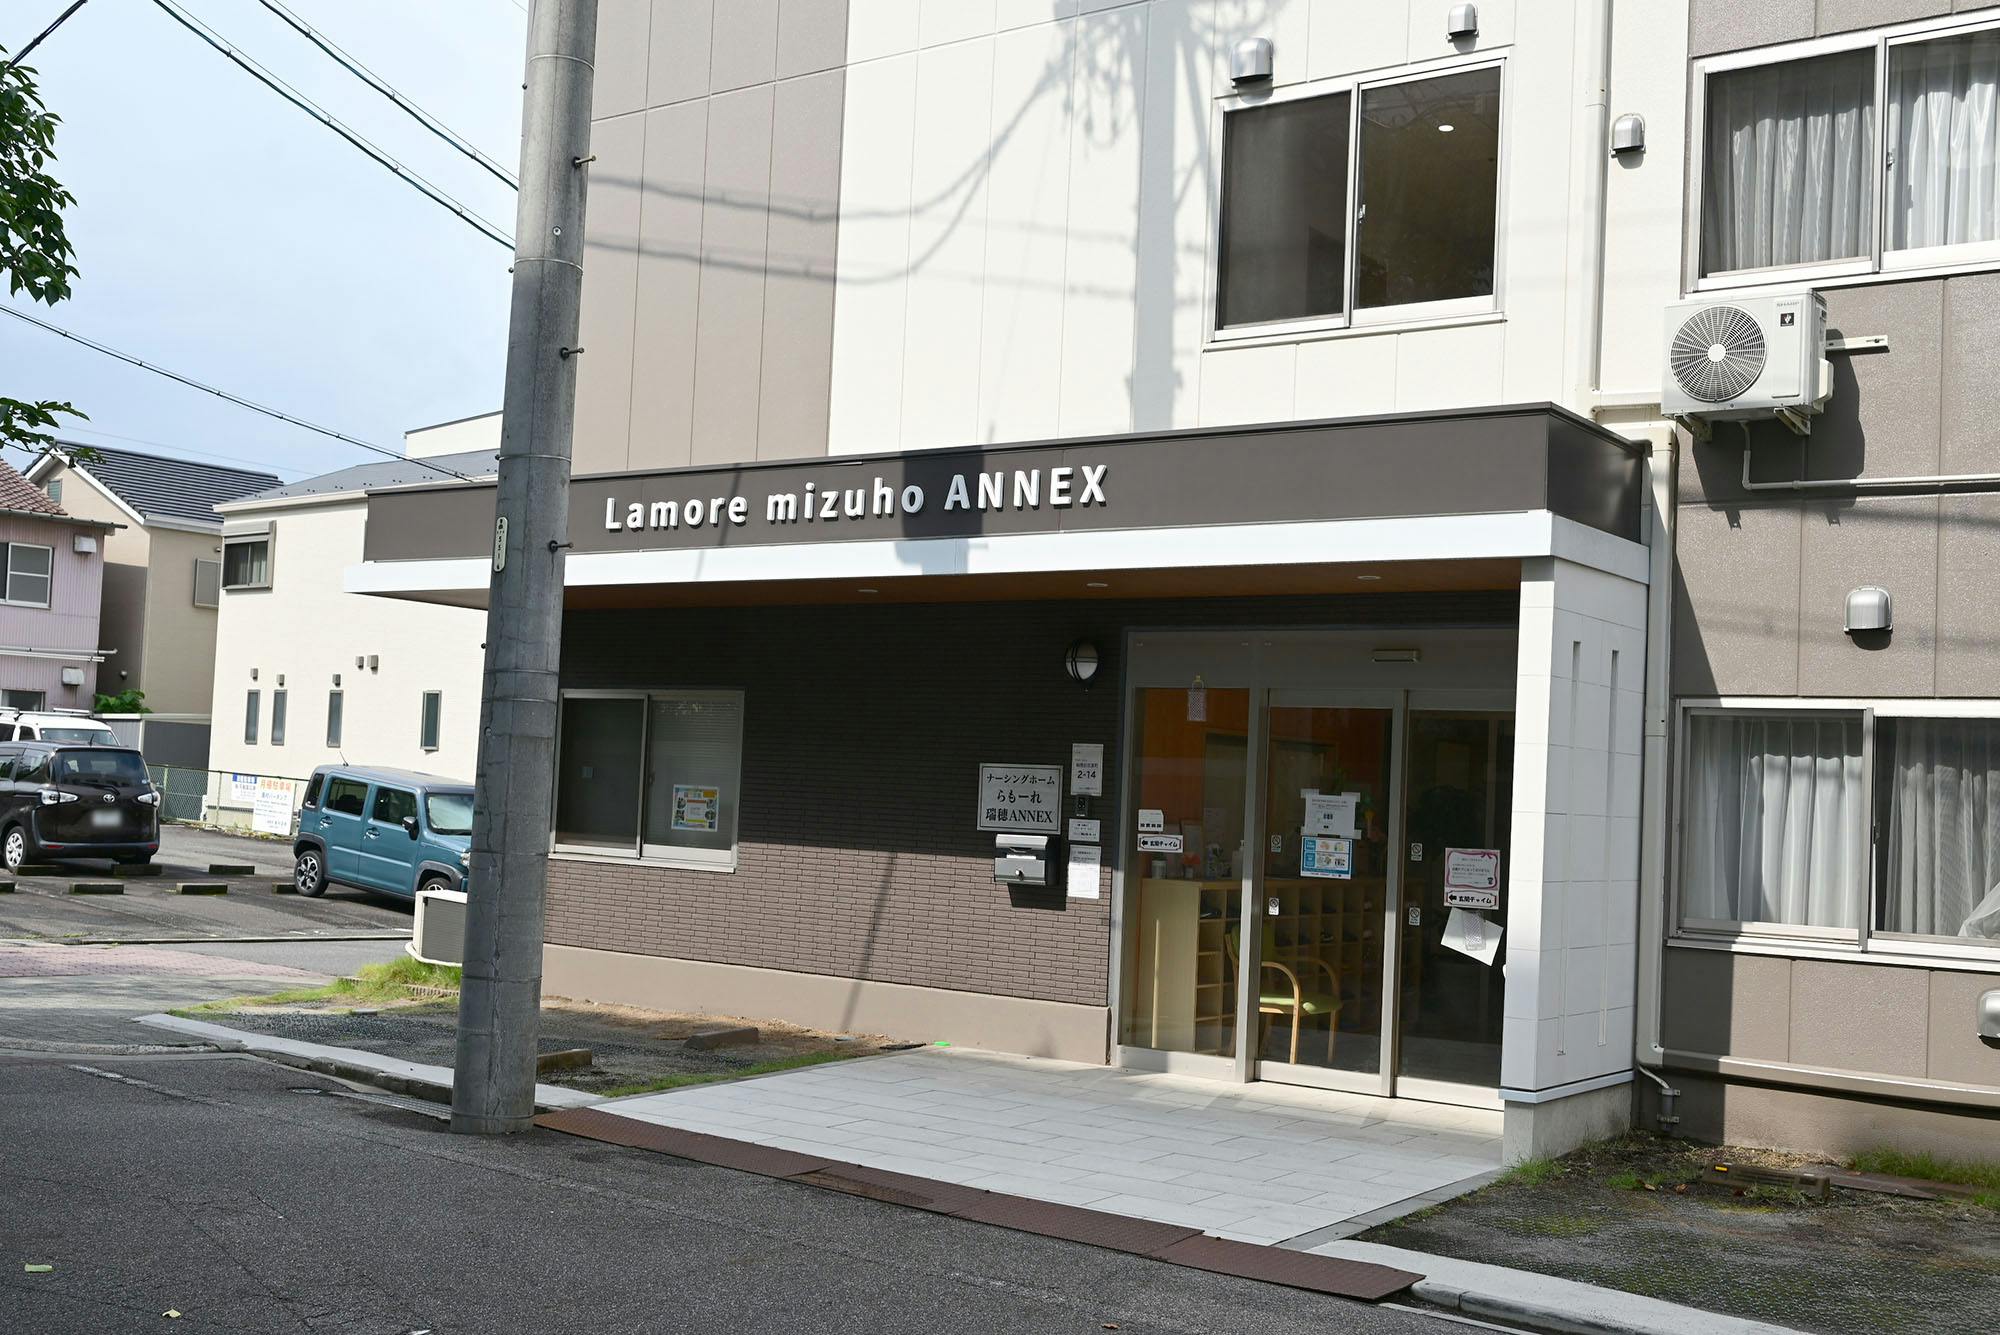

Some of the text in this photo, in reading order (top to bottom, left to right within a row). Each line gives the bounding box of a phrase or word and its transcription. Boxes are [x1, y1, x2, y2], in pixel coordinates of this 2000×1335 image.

[605, 464, 1108, 531] Lamore mizuho ANNEX
[986, 773, 1055, 785] ナーシングホーム
[997, 789, 1042, 804] らもーれ
[985, 807, 1053, 823] 瑞穂ANNEX
